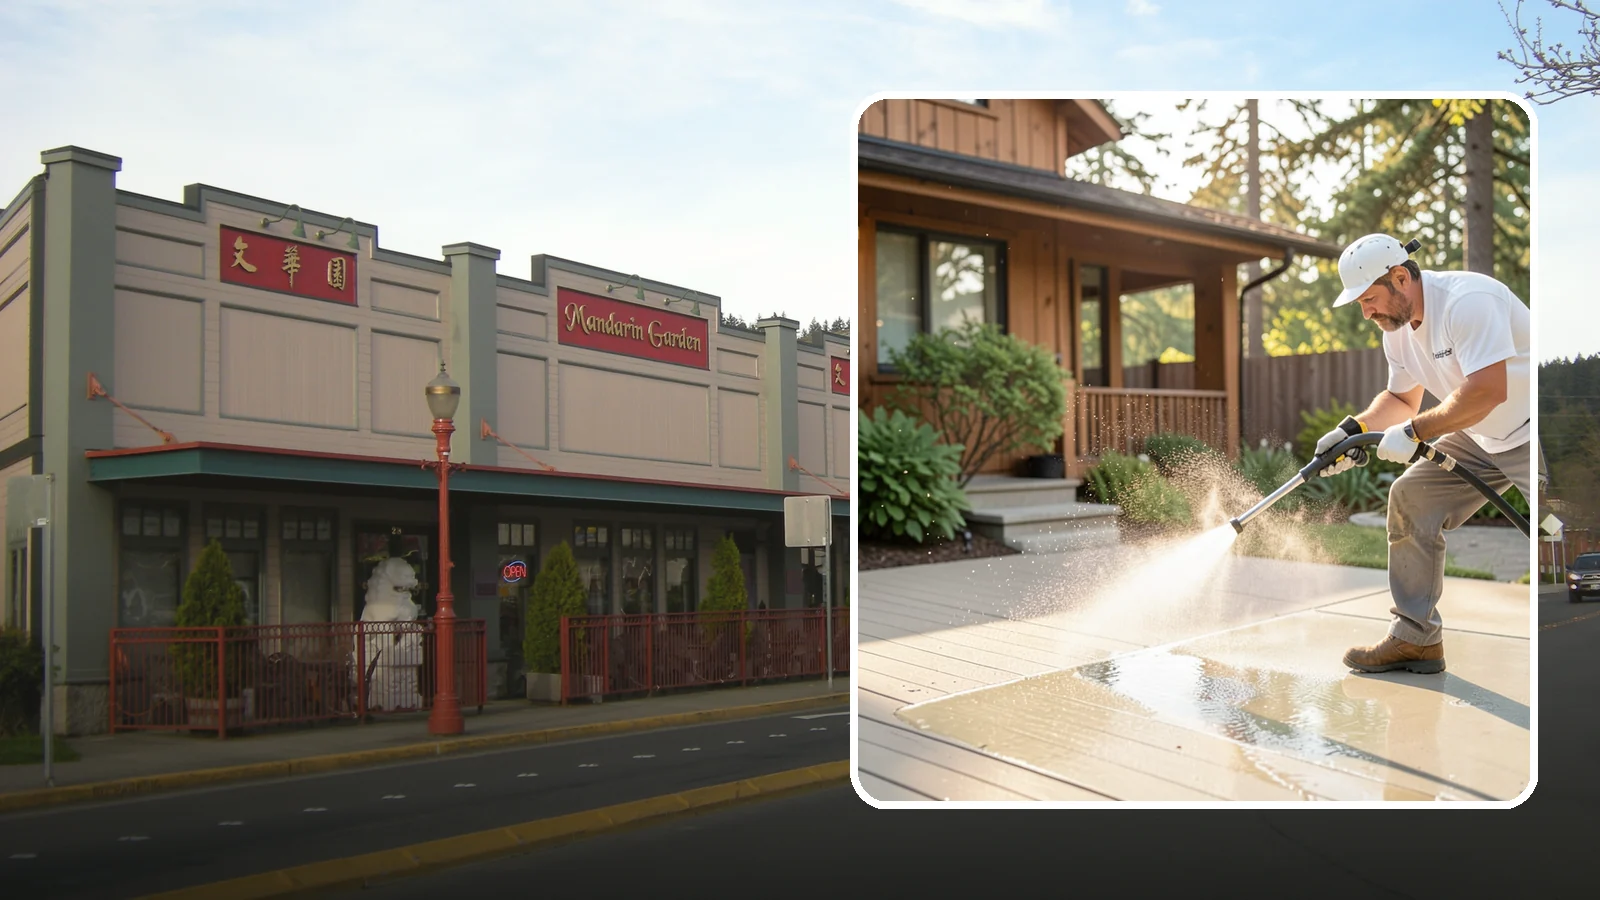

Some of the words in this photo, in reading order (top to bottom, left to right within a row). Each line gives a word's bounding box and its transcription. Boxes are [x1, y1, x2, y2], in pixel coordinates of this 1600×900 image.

[231, 236, 346, 291] 文華園
[564, 302, 644, 341] Mandarin
[648, 320, 701, 352] Garden
[503, 565, 527, 578] OPEN
